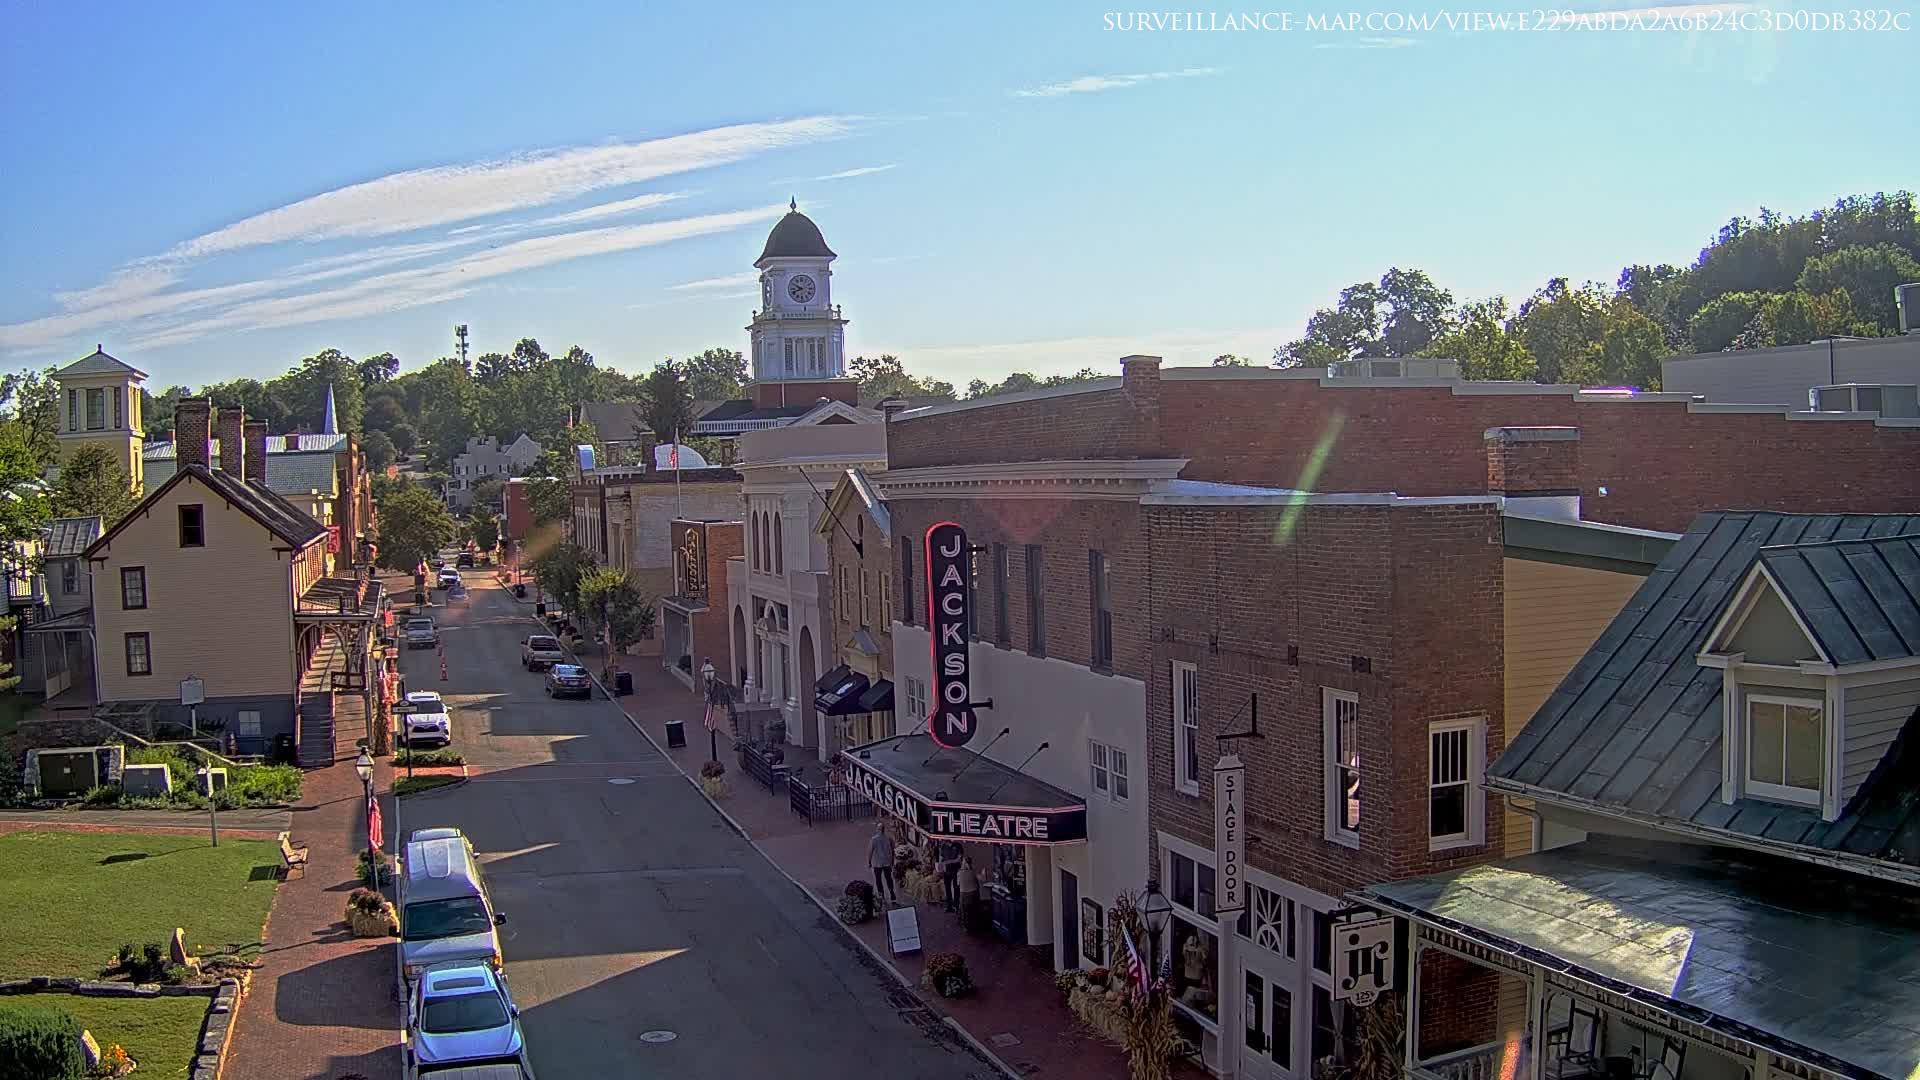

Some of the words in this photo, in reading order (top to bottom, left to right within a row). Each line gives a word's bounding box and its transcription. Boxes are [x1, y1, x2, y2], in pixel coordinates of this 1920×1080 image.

[940, 535, 968, 735] JACKSON
[845, 763, 918, 825] JACKSON
[931, 811, 1049, 838] THEATRE
[1225, 775, 1236, 842] STAGE
[1225, 850, 1237, 903] DOOR
